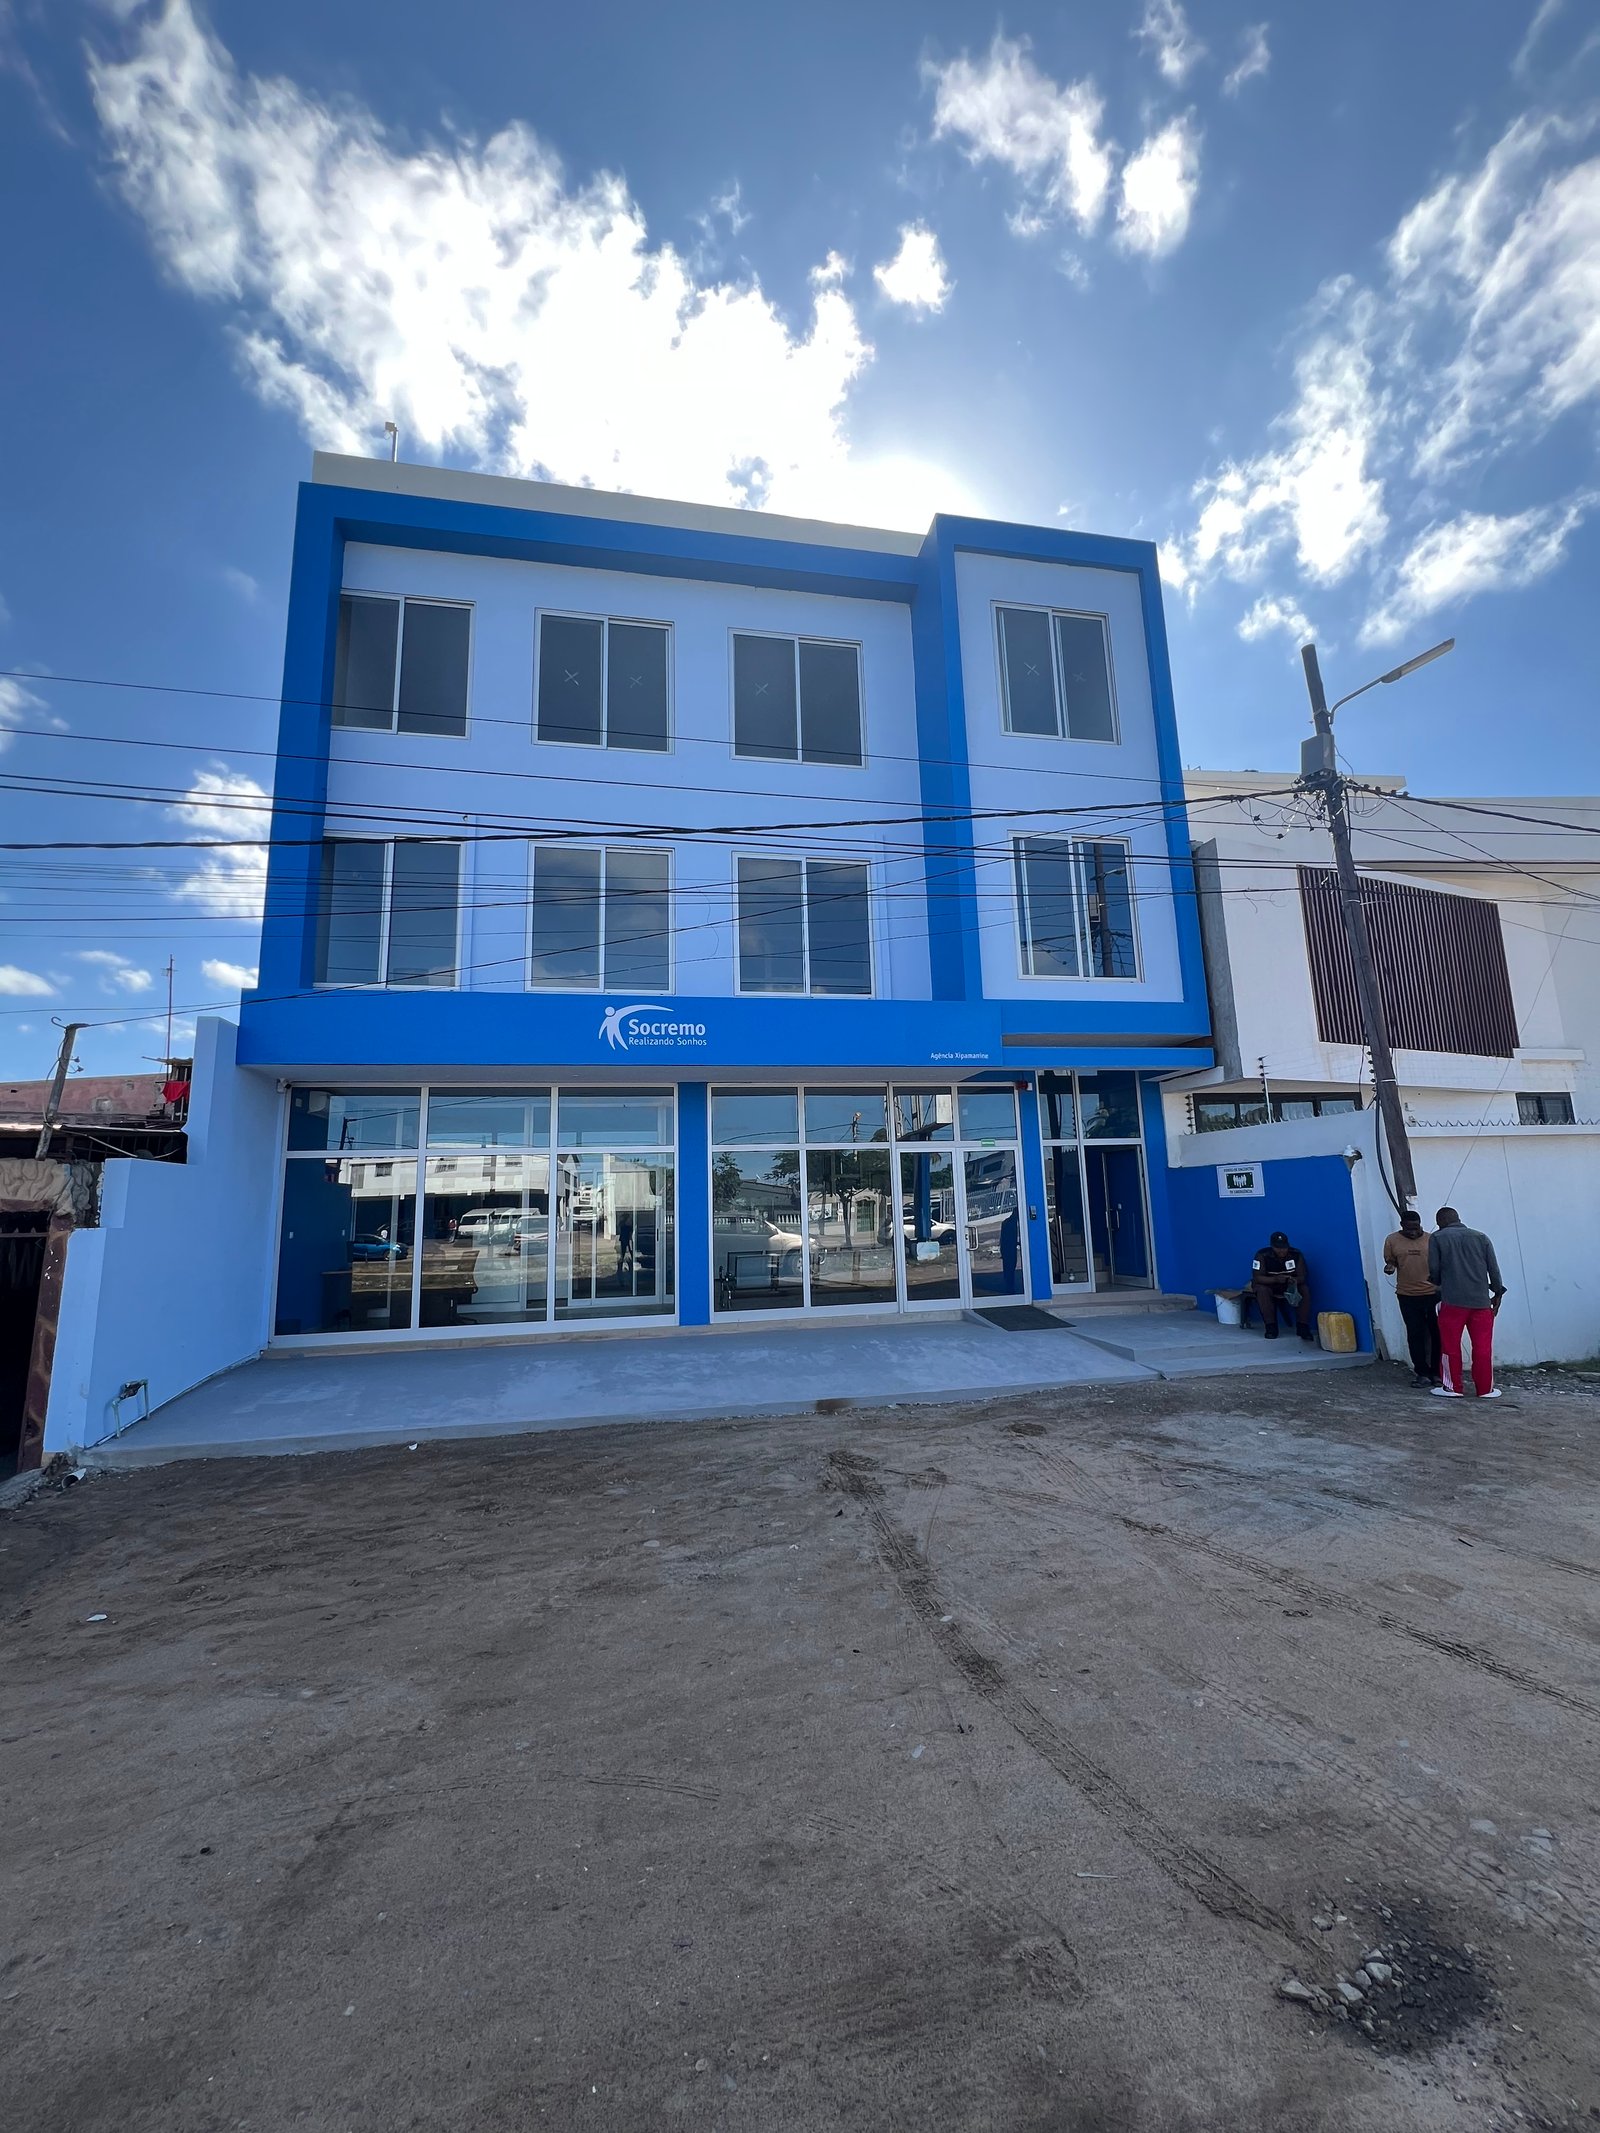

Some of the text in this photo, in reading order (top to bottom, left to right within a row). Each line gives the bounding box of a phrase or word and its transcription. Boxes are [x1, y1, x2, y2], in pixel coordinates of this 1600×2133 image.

[628, 1019, 706, 1035] Socremo
[628, 1036, 707, 1046] Realizando Sonhos
[930, 1052, 953, 1060] Agência
